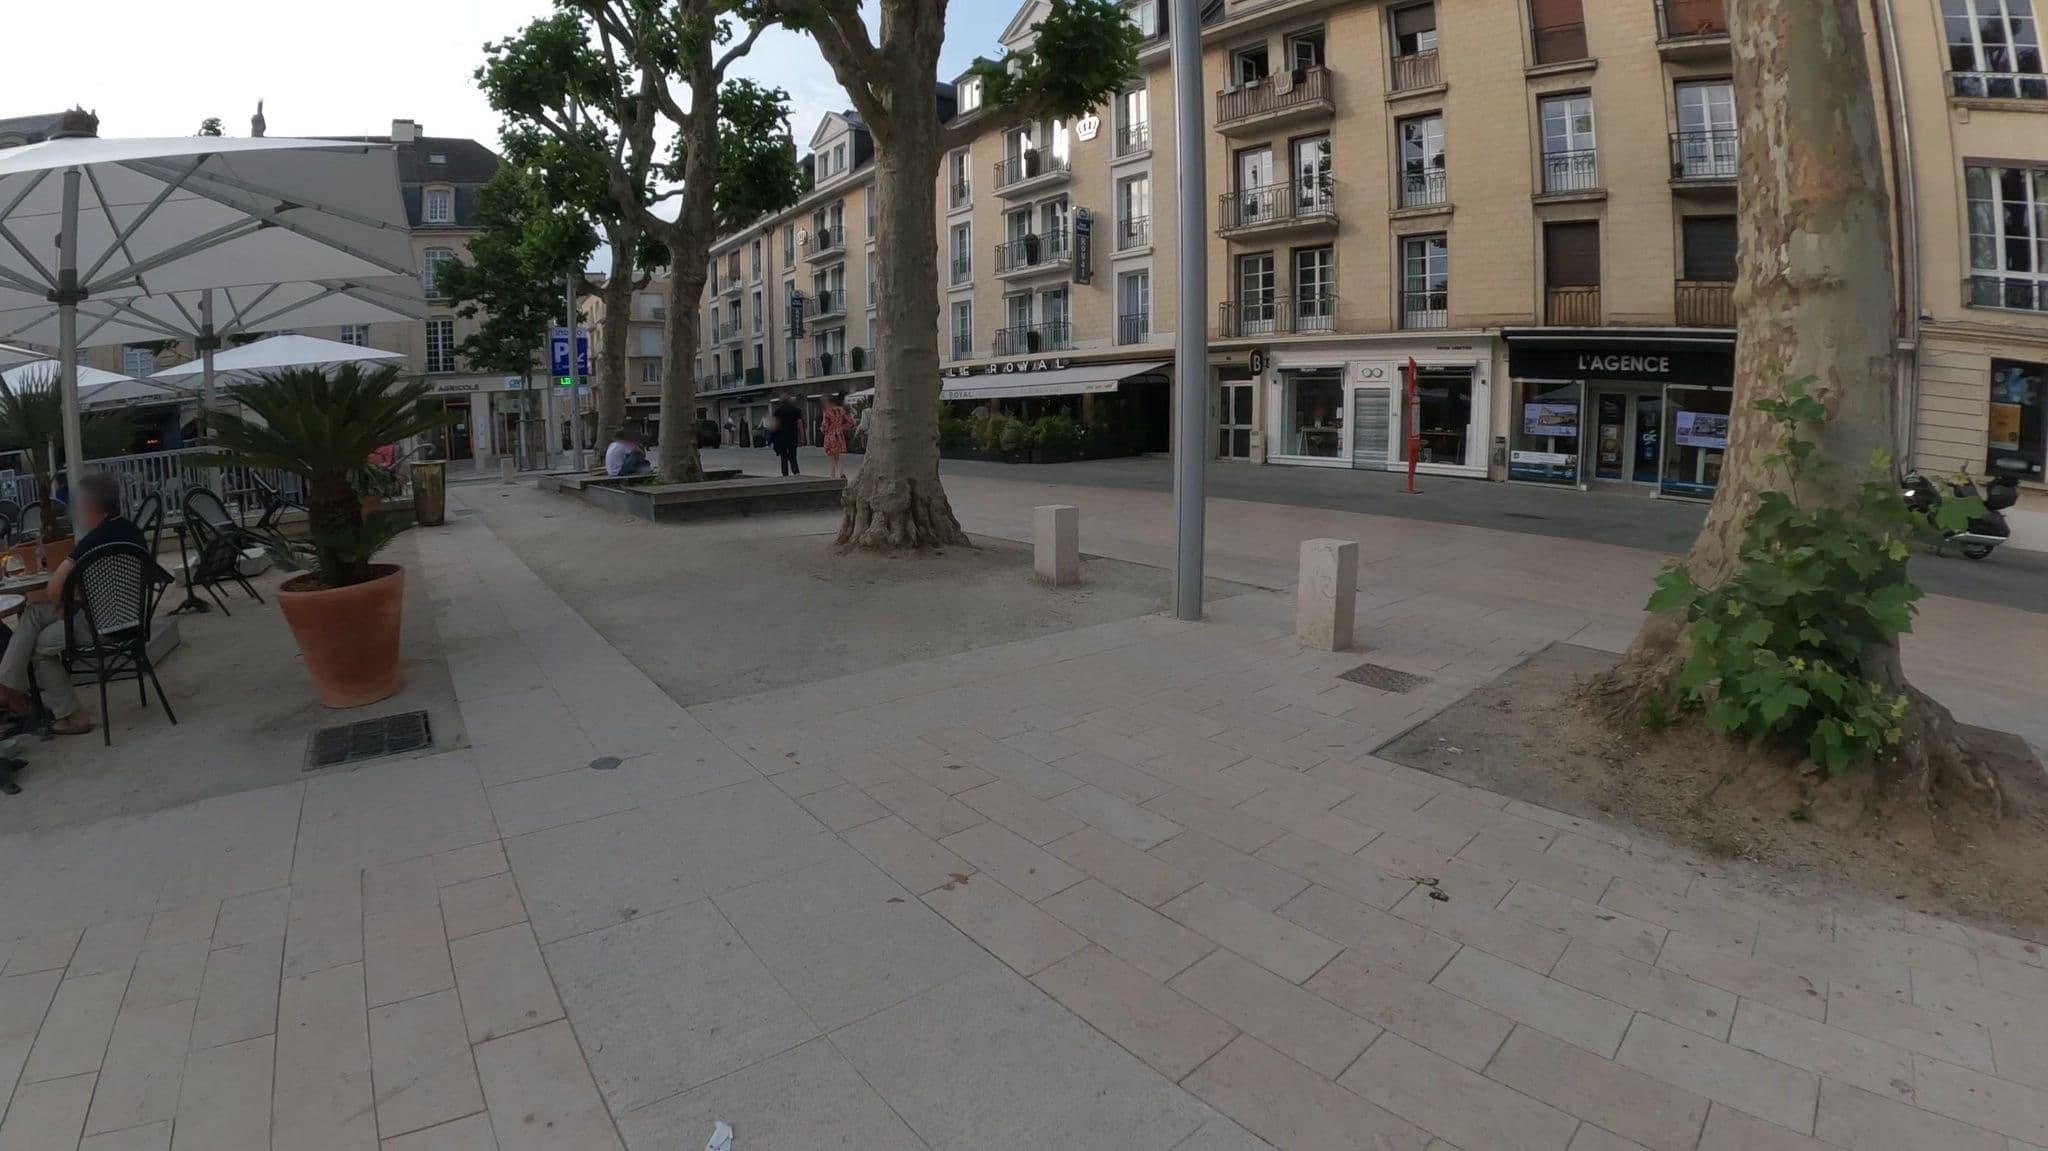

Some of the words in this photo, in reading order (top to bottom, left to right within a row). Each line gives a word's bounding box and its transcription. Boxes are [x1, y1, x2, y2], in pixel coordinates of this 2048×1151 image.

[945, 365, 970, 378] LE
[989, 358, 1066, 375] ROYAL
[1253, 354, 1262, 371] B
[1578, 354, 1671, 373] L'AGENCE
